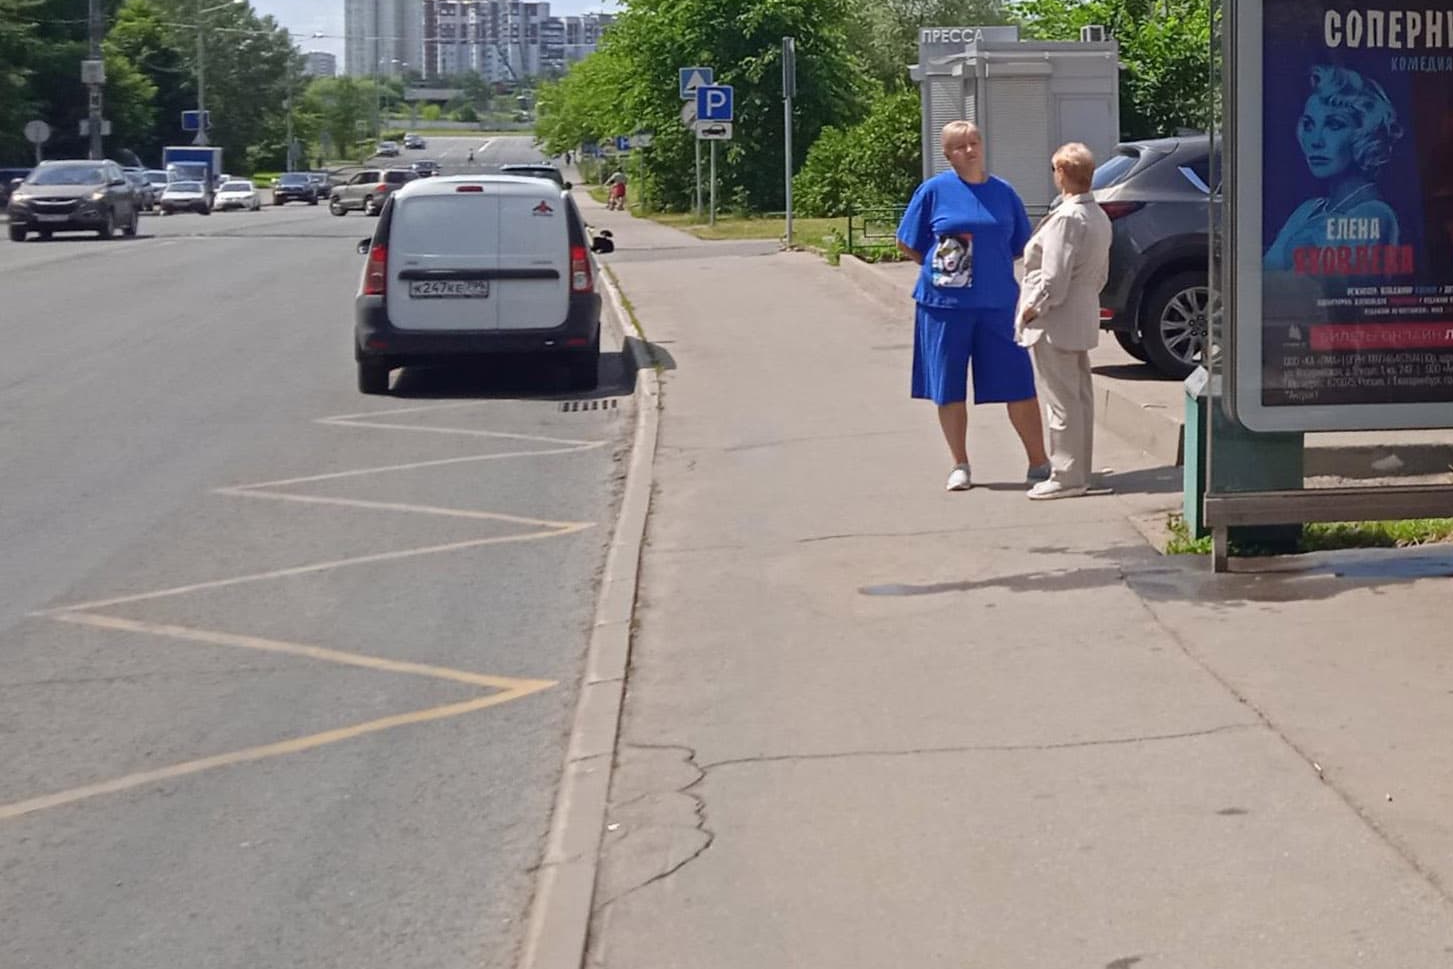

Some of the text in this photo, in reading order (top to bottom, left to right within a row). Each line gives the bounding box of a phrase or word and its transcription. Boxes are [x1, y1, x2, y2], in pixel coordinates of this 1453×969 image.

[922, 28, 984, 43] ПРЕССА
[1391, 56, 1453, 72] КОМЕДИЯ
[707, 89, 727, 117] P
[1326, 217, 1381, 241] ЕЛЕНА
